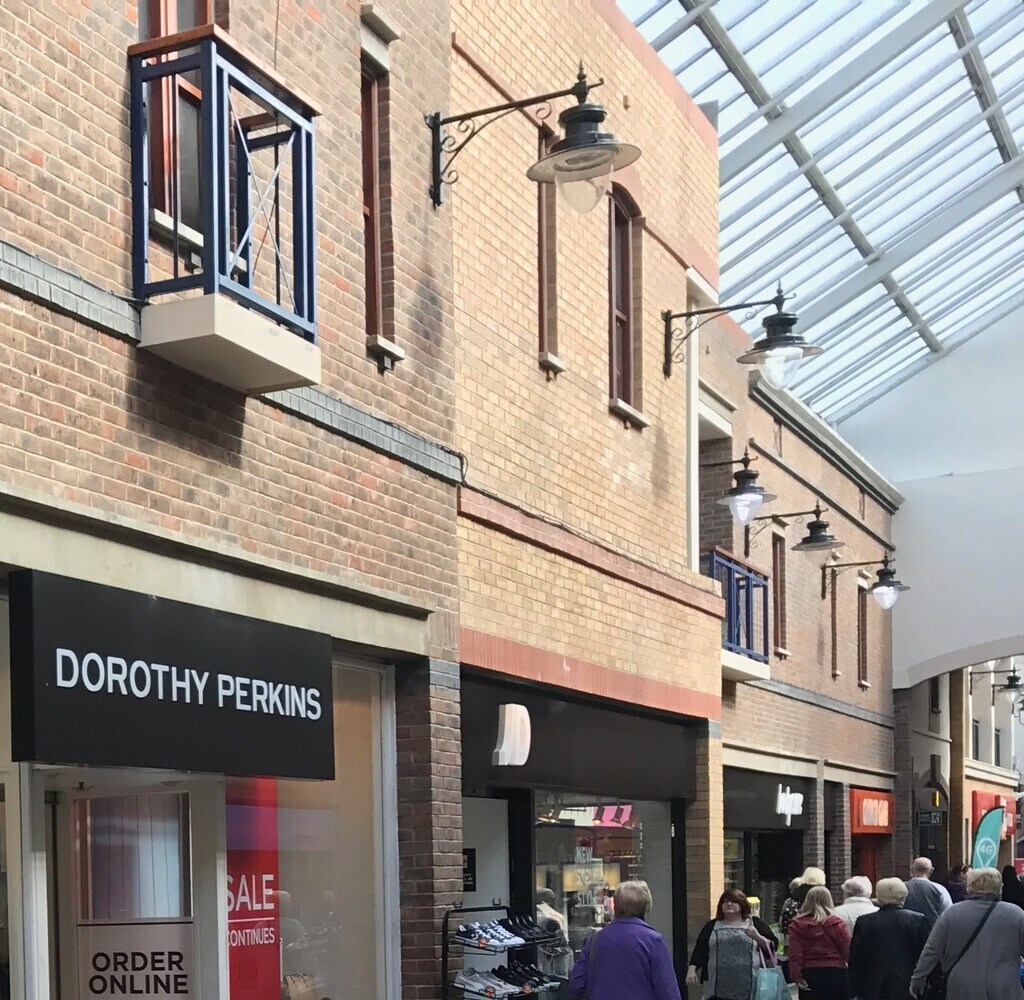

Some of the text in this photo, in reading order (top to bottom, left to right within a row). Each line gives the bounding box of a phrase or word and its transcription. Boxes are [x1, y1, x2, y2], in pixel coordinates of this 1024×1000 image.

[56, 648, 322, 720] DOROTHY PERKINS
[979, 844, 993, 855] 4G
[226, 874, 275, 913] SALE
[228, 927, 276, 947] ONTINUES
[92, 951, 185, 973] ORDER
[88, 974, 189, 995] ONLINE
